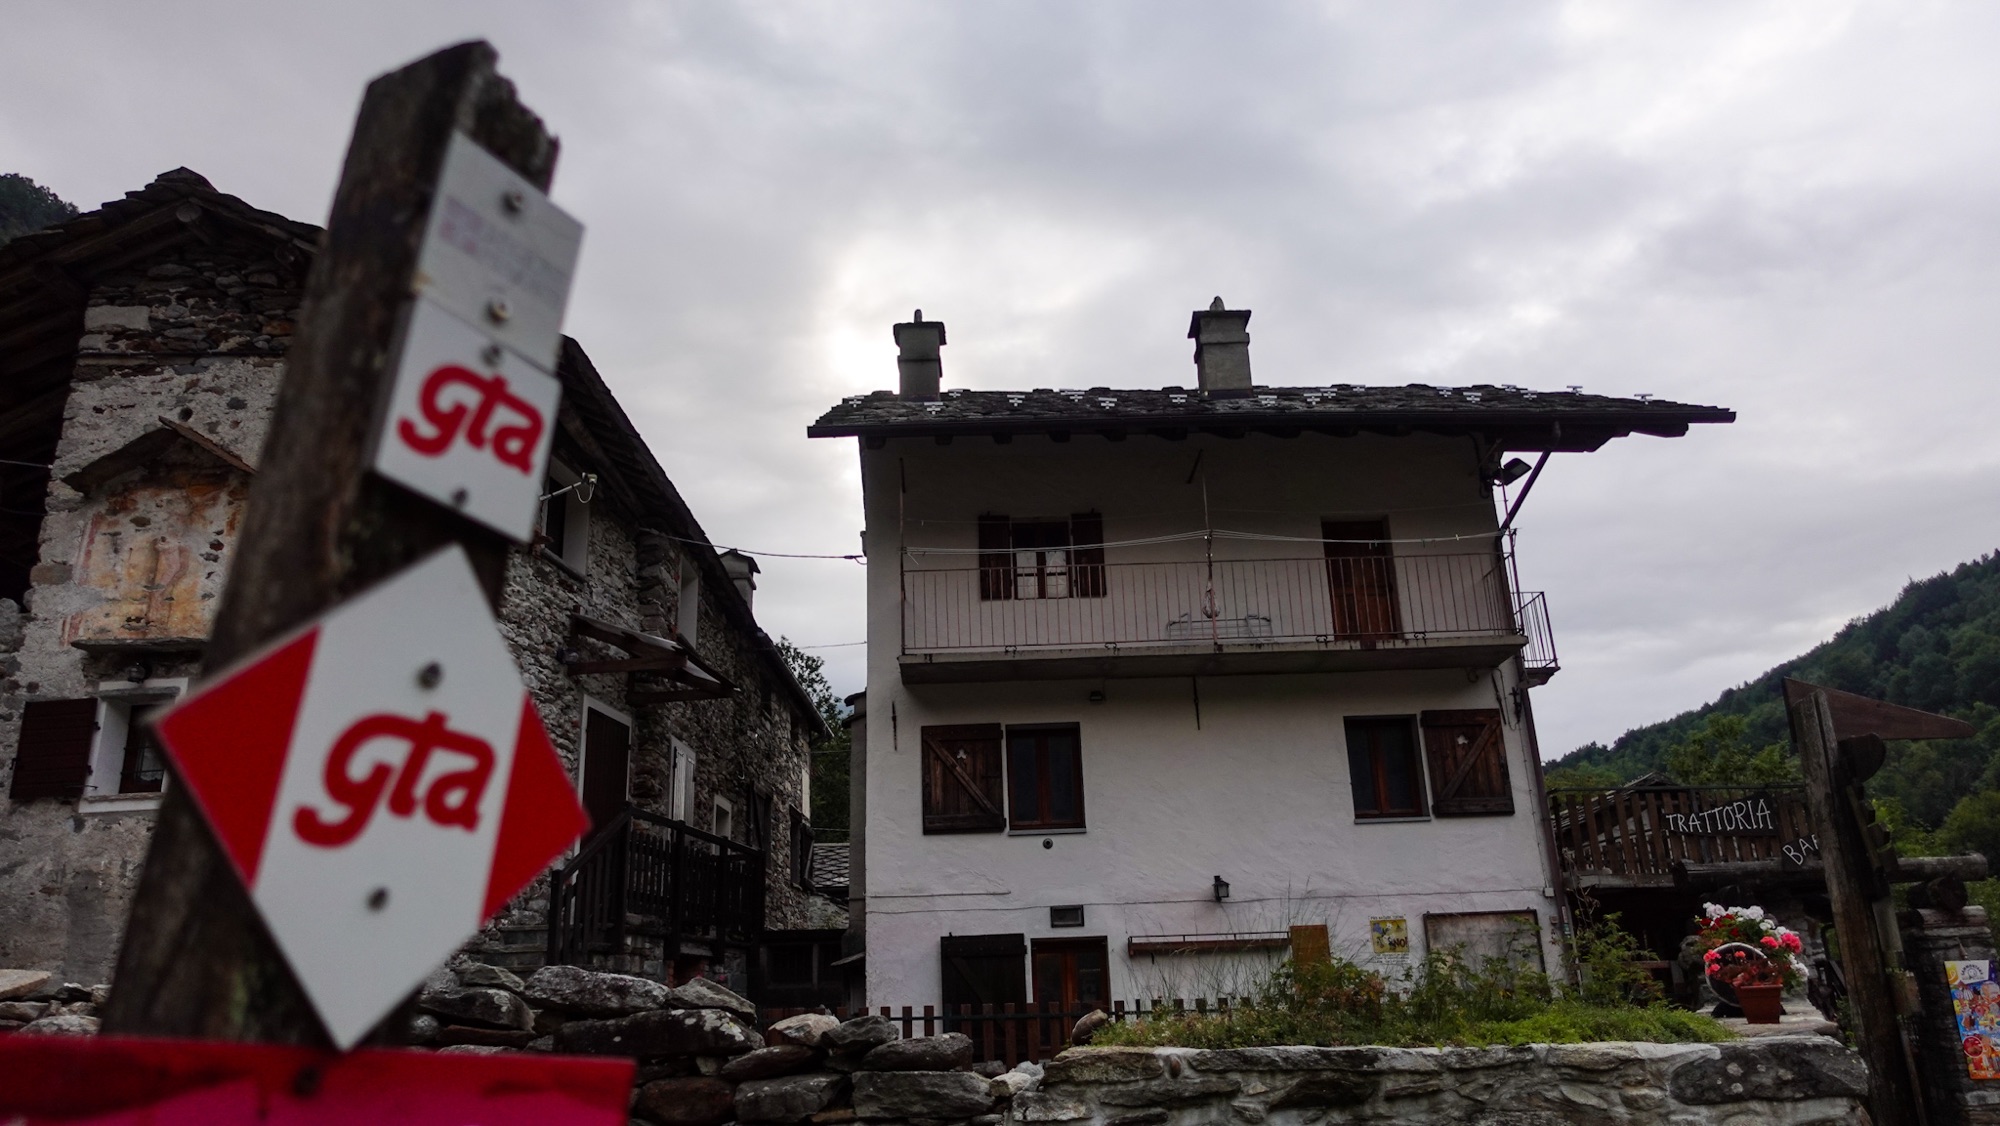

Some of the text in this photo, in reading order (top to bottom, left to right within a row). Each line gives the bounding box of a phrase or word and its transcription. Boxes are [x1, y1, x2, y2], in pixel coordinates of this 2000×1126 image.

[397, 364, 544, 476] gta
[291, 709, 497, 849] gta
[1665, 798, 1773, 833] TRATTORIA
